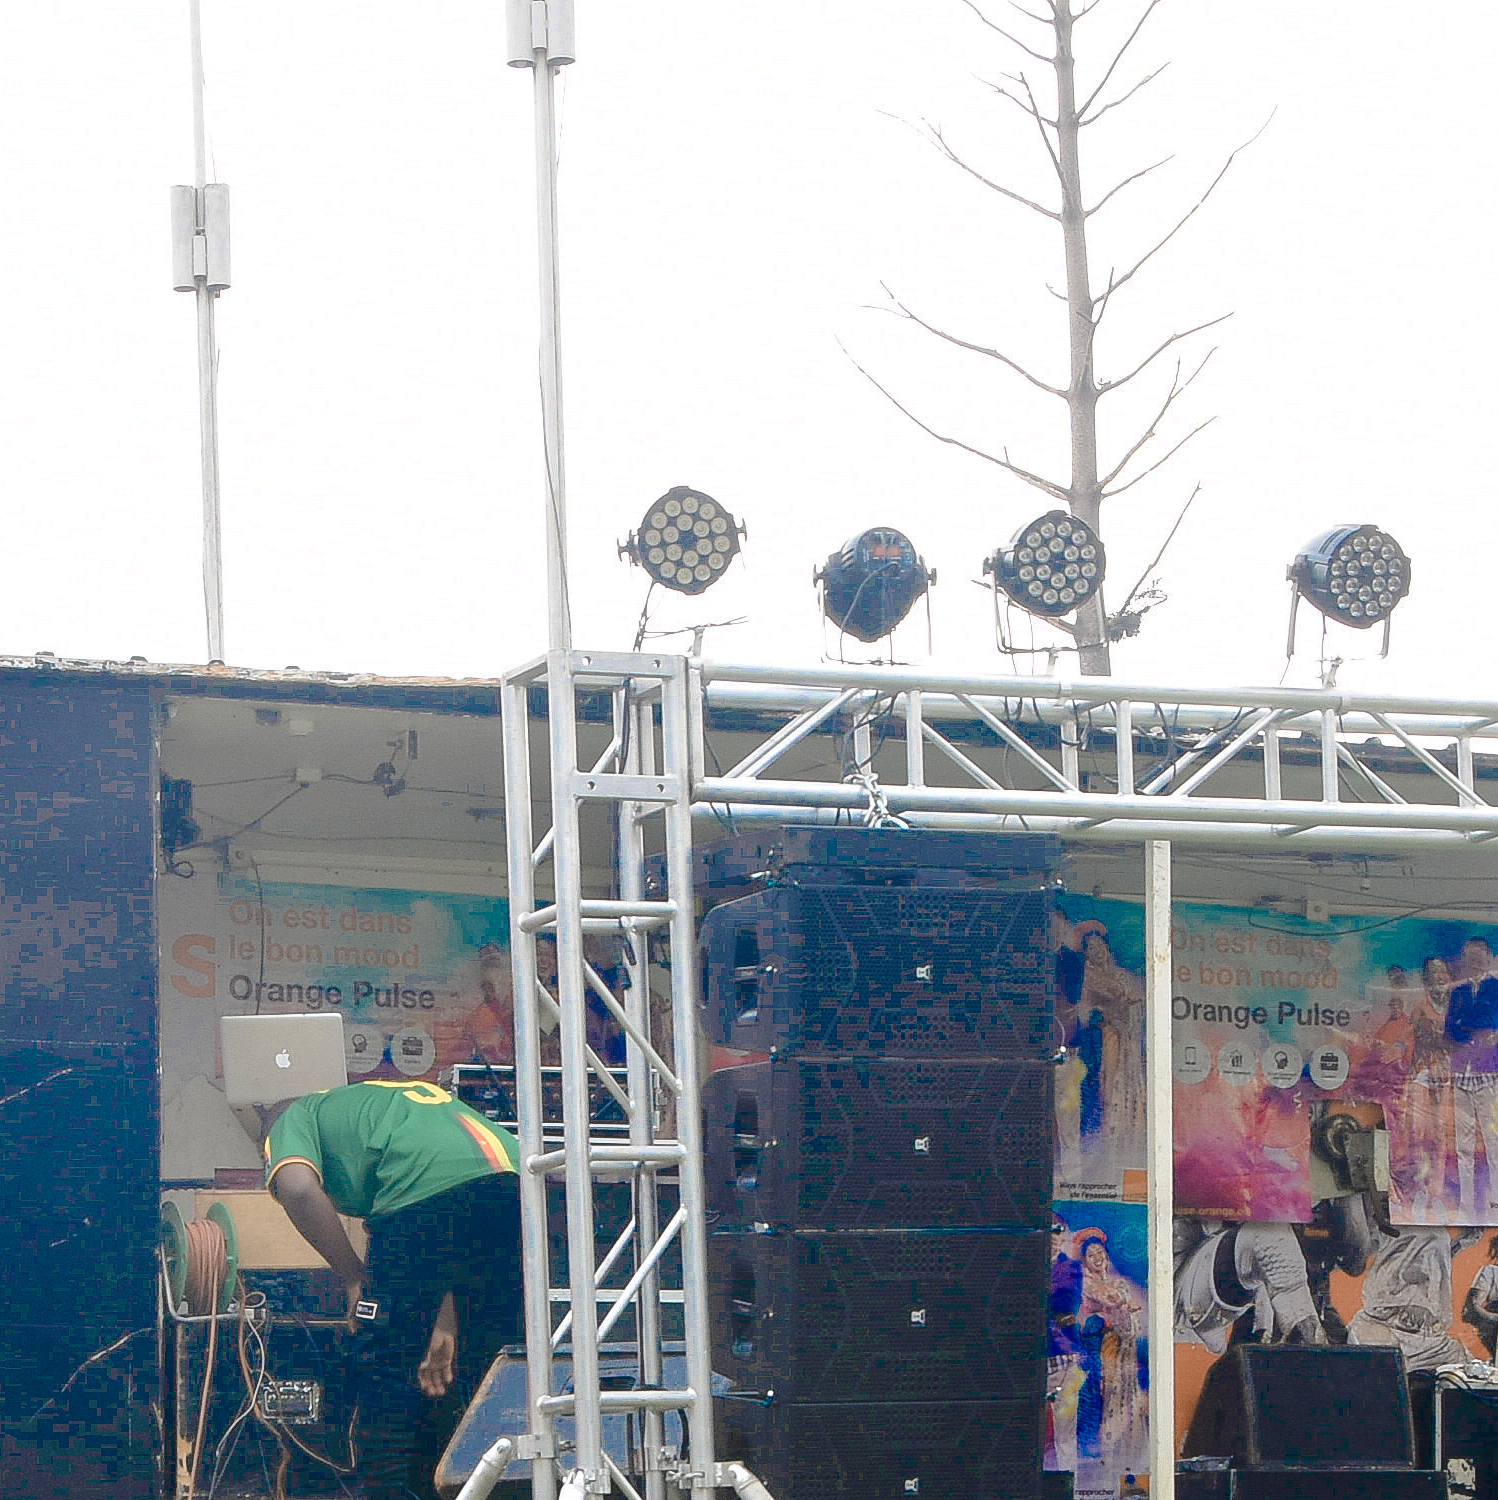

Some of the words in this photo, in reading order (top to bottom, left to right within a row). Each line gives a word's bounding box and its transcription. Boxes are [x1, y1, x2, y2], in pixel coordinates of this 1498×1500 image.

[229, 900, 272, 926] On
[283, 906, 330, 929] est
[339, 905, 413, 934] dans
[229, 935, 255, 960] le
[266, 936, 323, 963] bon
[334, 944, 420, 968] mood
[1215, 932, 1257, 954] est
[1266, 936, 1333, 959] dans
[229, 974, 342, 1010] Orange
[354, 981, 435, 1009] Pulse
[1172, 963, 1191, 983] e
[1200, 962, 1251, 986] bon
[1261, 967, 1338, 989] mood
[1172, 996, 1269, 1029] Orange
[1278, 1001, 1350, 1027] Pulse
